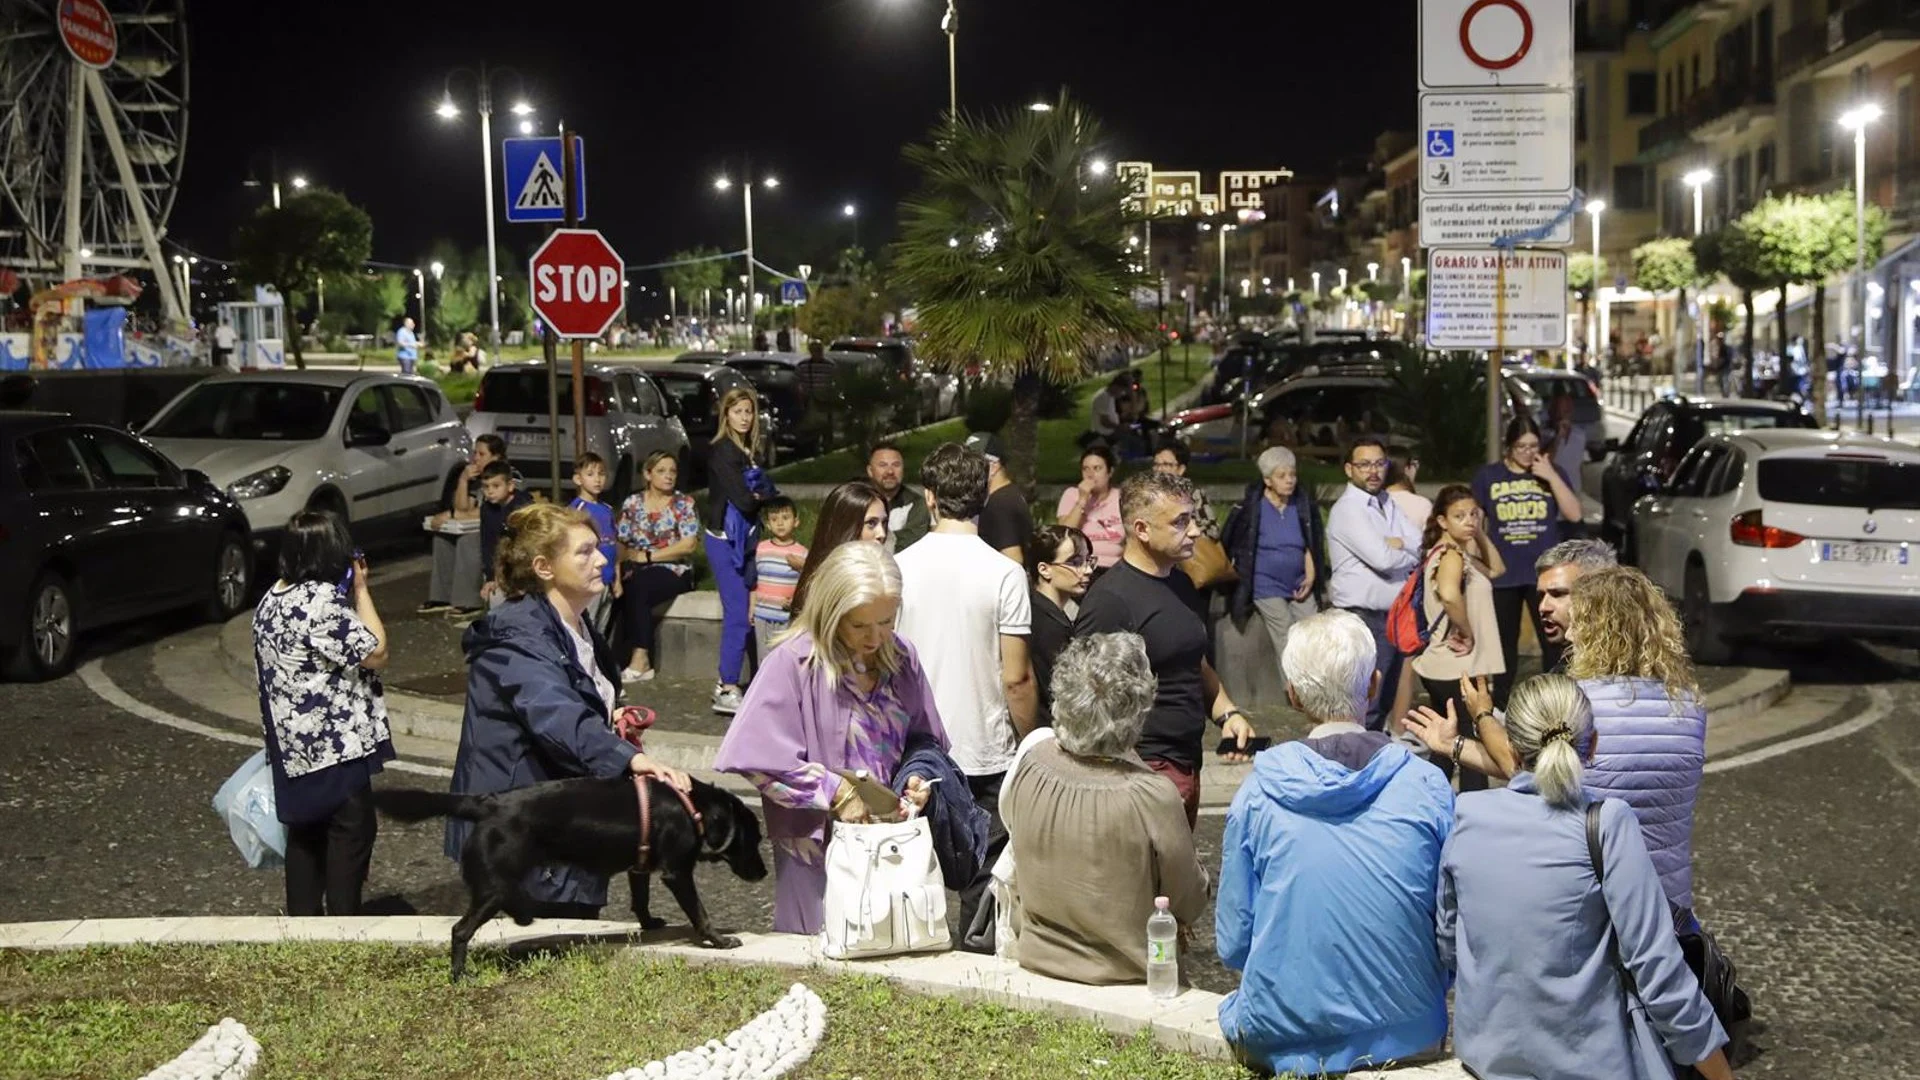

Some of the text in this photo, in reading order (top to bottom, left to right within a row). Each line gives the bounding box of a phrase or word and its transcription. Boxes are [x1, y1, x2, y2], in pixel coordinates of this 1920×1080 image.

[1426, 202, 1463, 213] controllo
[1467, 202, 1512, 212] elettronico
[1515, 201, 1535, 213] degli
[1430, 217, 1485, 227] informazioni
[1488, 217, 1497, 226] ed
[1441, 230, 1473, 239] numero
[1476, 228, 1499, 238] verde
[1435, 256, 1562, 269] ORARIO VARCHI ATTIVI
[537, 264, 618, 303] STOP
